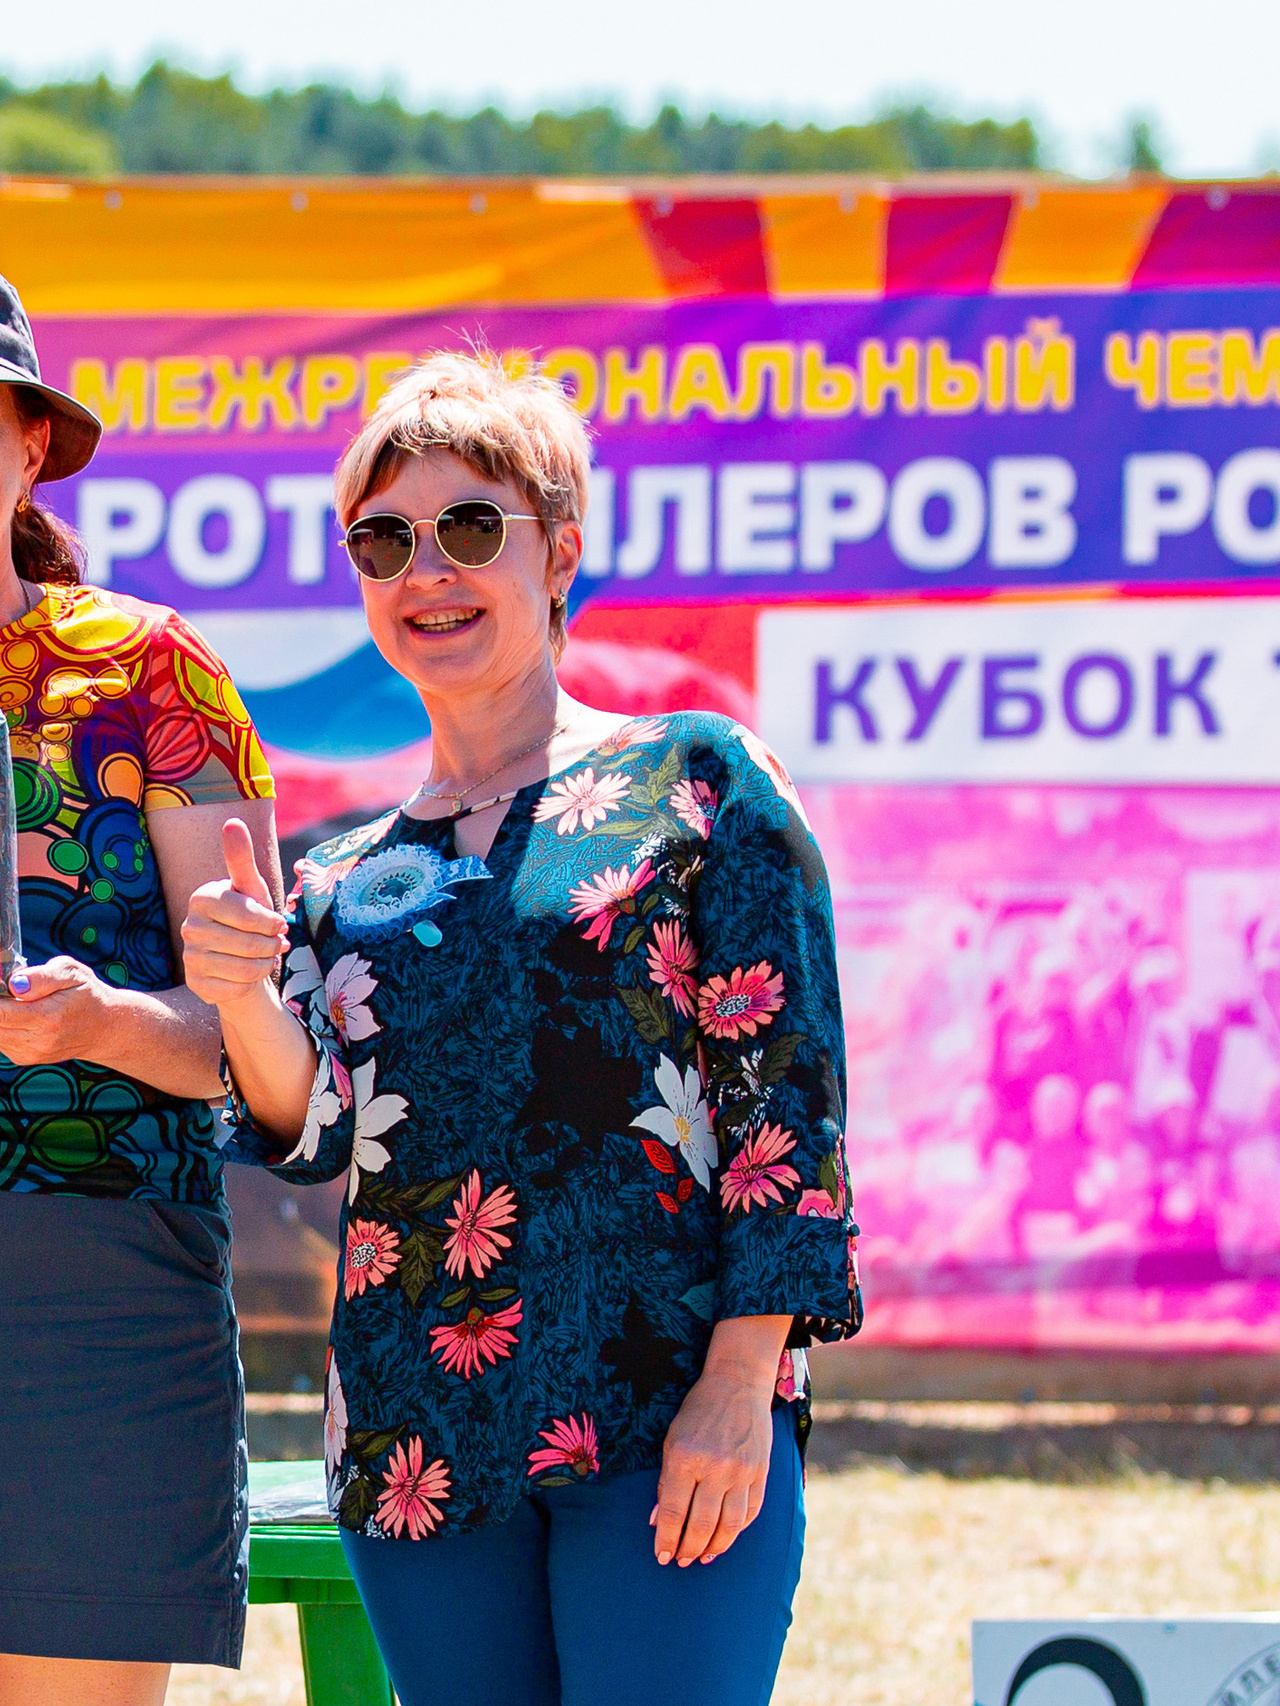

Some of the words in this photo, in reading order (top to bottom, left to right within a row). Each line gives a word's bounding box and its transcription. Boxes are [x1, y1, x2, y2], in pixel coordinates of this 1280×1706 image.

[71, 318, 1075, 433] МЕЖРЕОНАЛЬНЫЙ
[77, 455, 1078, 588] РОТЛЕРОВ
[815, 650, 1219, 745] КУБОК
